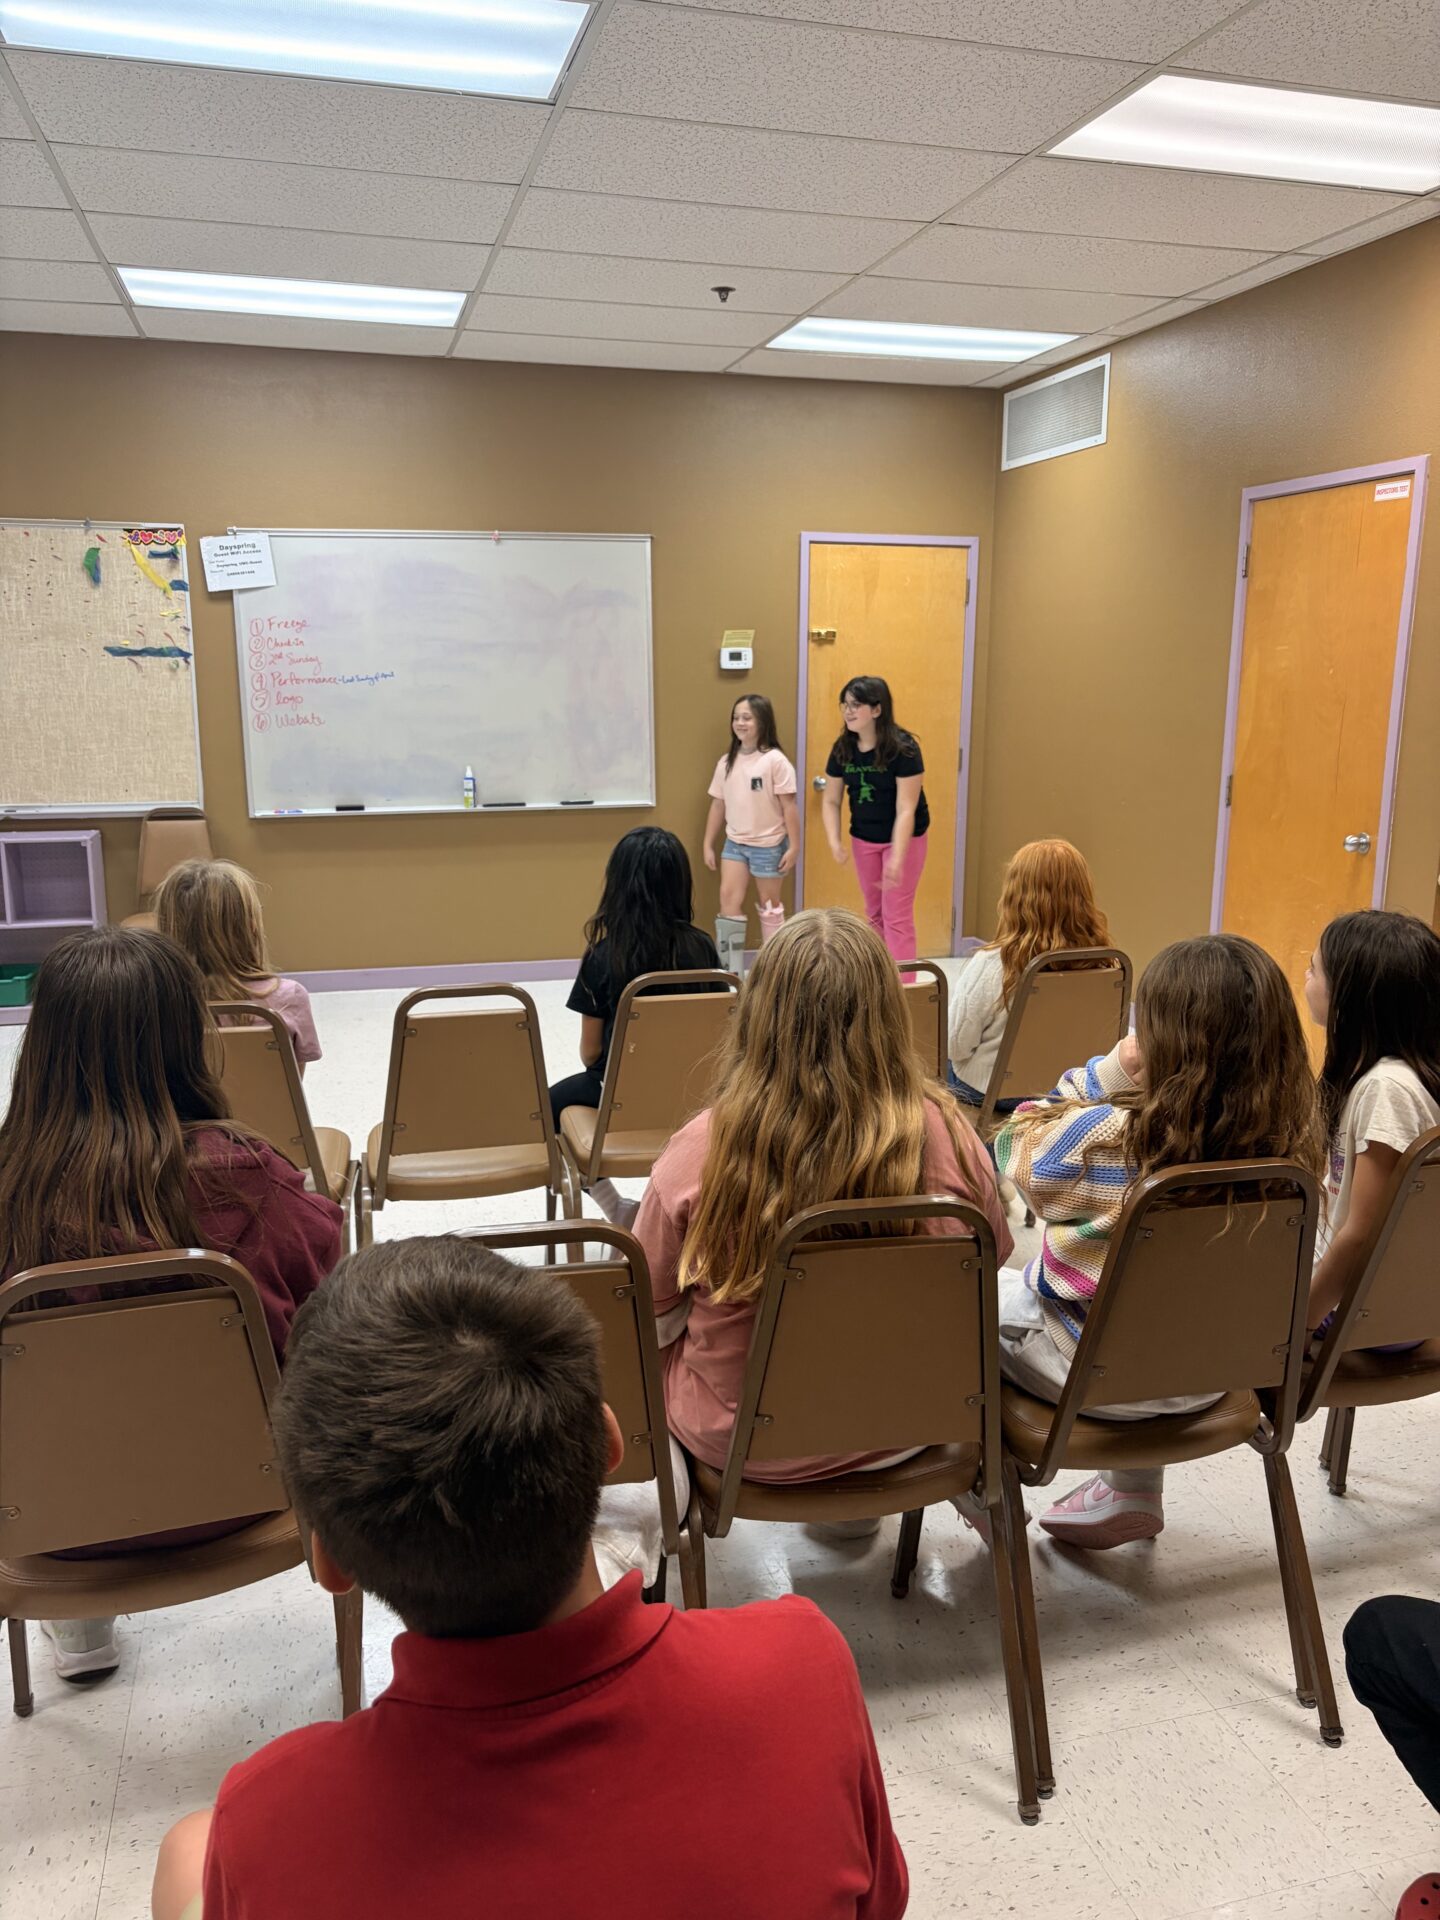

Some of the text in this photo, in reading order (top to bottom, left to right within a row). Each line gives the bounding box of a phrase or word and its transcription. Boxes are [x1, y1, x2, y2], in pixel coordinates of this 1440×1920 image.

[218, 542, 256, 551] Dayspring
[267, 616, 310, 633] Freeze
[286, 652, 322, 675] Sunday
[276, 712, 326, 729] Website
